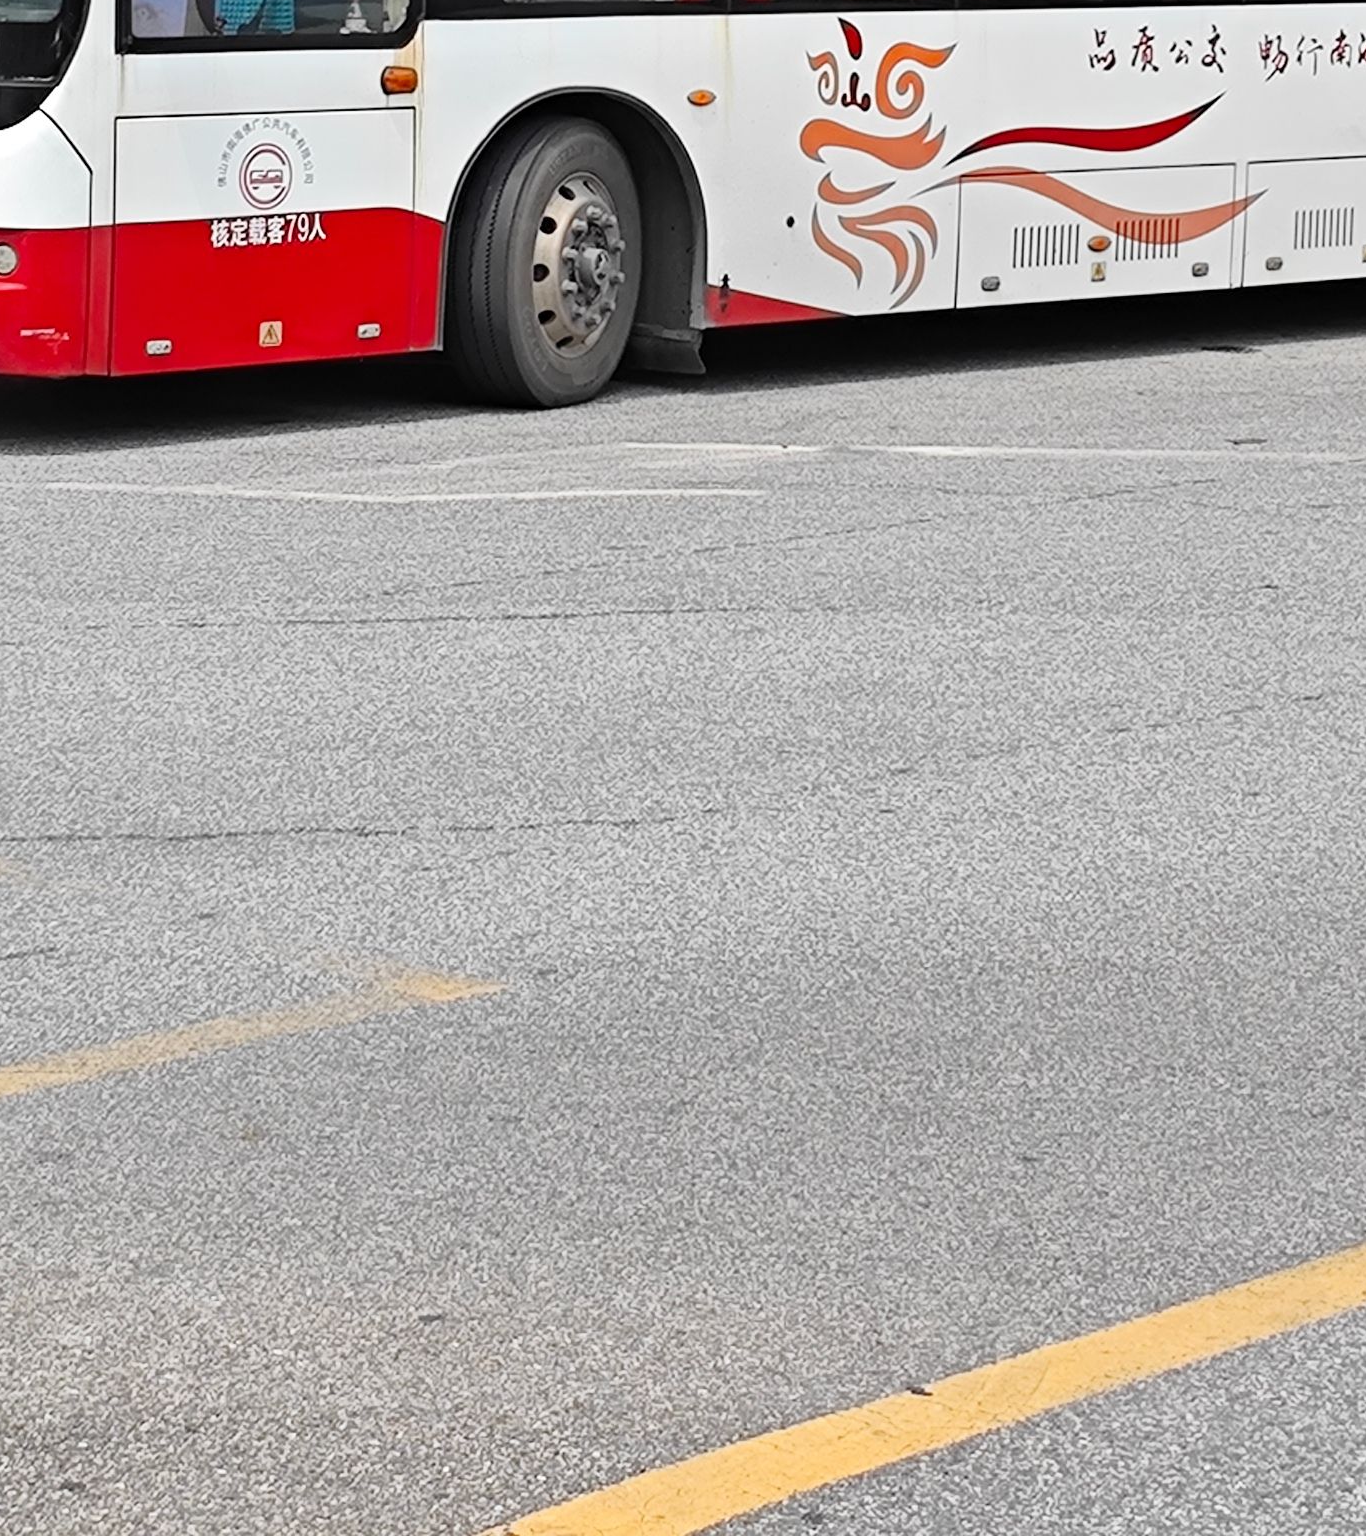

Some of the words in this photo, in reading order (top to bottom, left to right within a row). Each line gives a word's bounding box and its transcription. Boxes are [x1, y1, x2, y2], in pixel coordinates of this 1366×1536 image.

[1088, 24, 1227, 74] 品质公交
[210, 212, 327, 249] 核定载客79人
